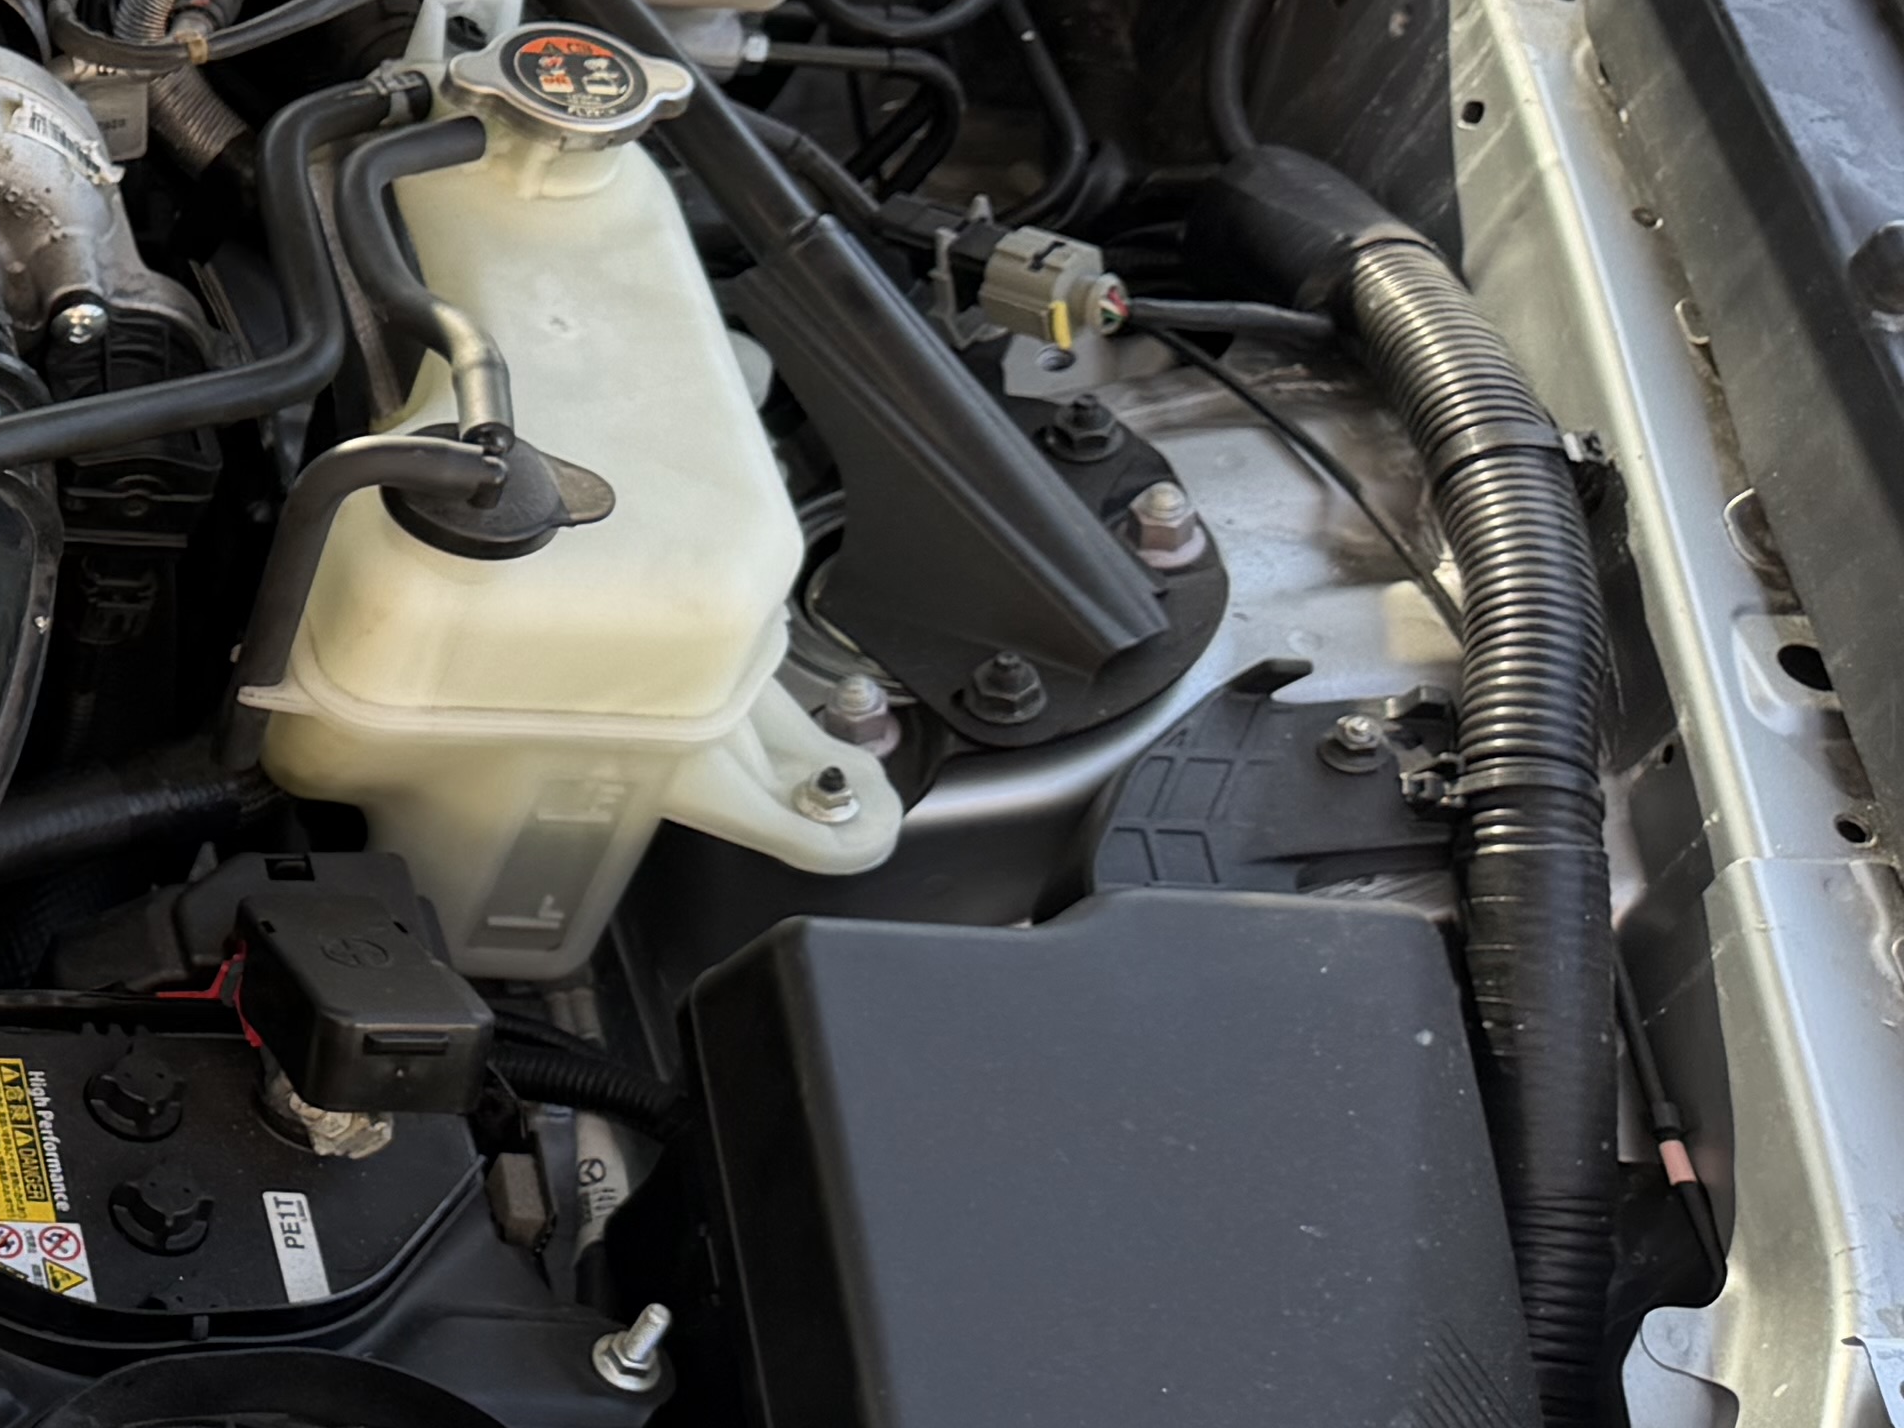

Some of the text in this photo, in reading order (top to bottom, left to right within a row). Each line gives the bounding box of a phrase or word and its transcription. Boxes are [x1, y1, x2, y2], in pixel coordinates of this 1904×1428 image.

[28, 1070, 70, 1212] High Performance
[20, 1148, 45, 1201] DANGER
[273, 1195, 305, 1249] PE1T
